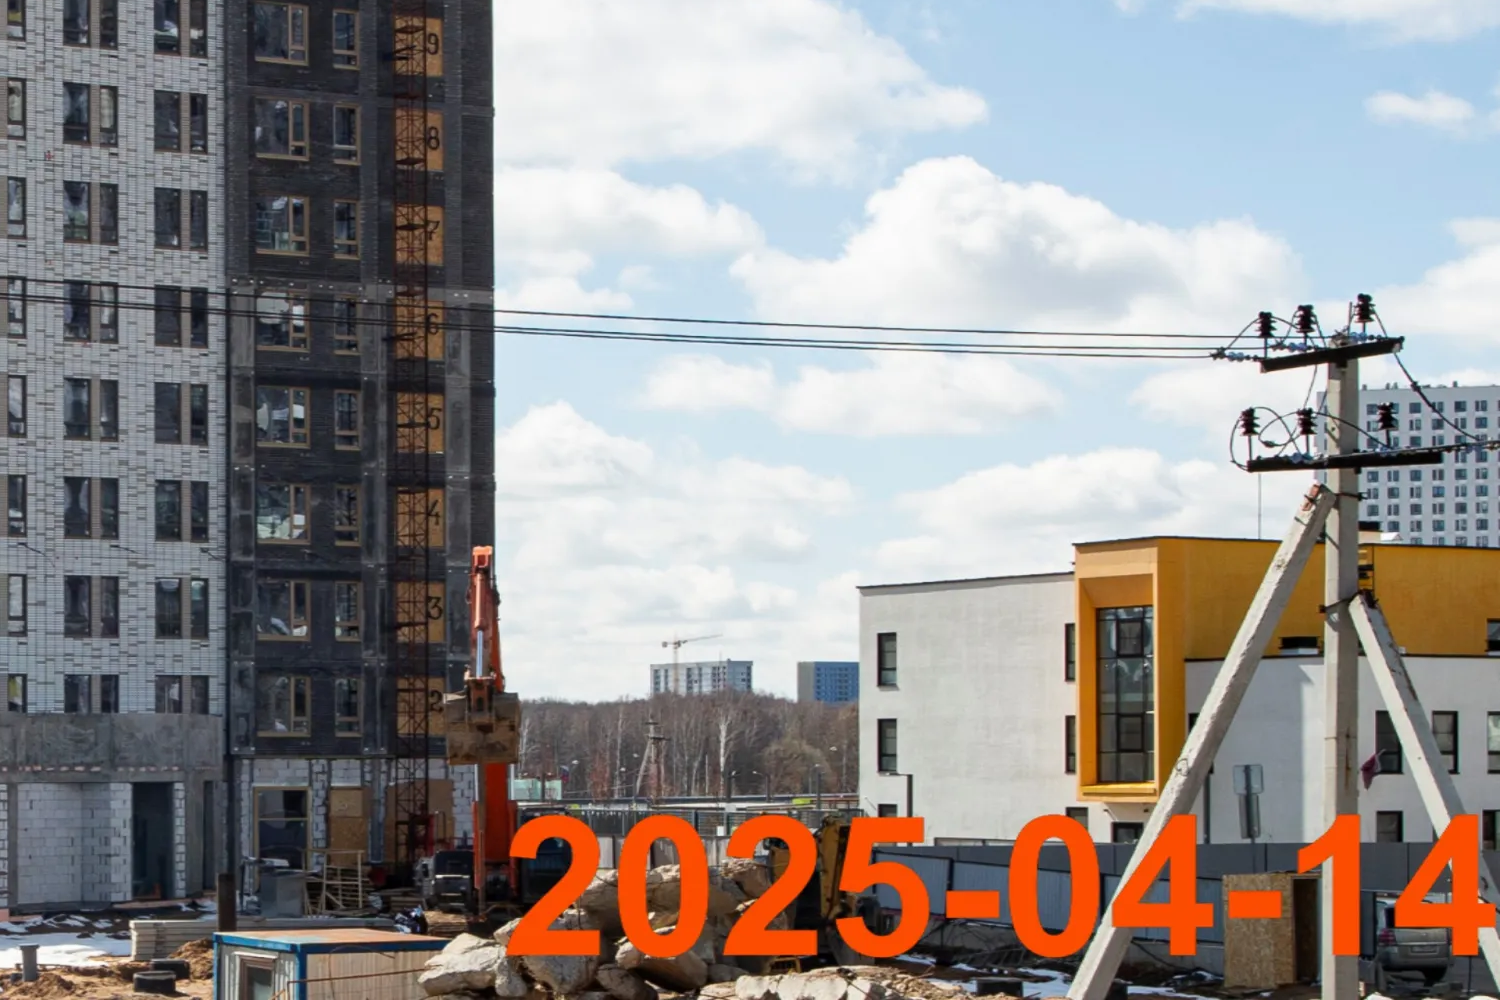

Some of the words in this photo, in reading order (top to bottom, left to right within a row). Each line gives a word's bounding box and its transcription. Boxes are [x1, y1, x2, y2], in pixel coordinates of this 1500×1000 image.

[427, 32, 439, 55] 9
[428, 126, 440, 150] 8
[426, 220, 440, 241] 7
[427, 312, 439, 335] 6
[428, 406, 442, 430] 5
[428, 498, 441, 526] 4
[427, 595, 443, 620] 3
[429, 689, 444, 713] 2
